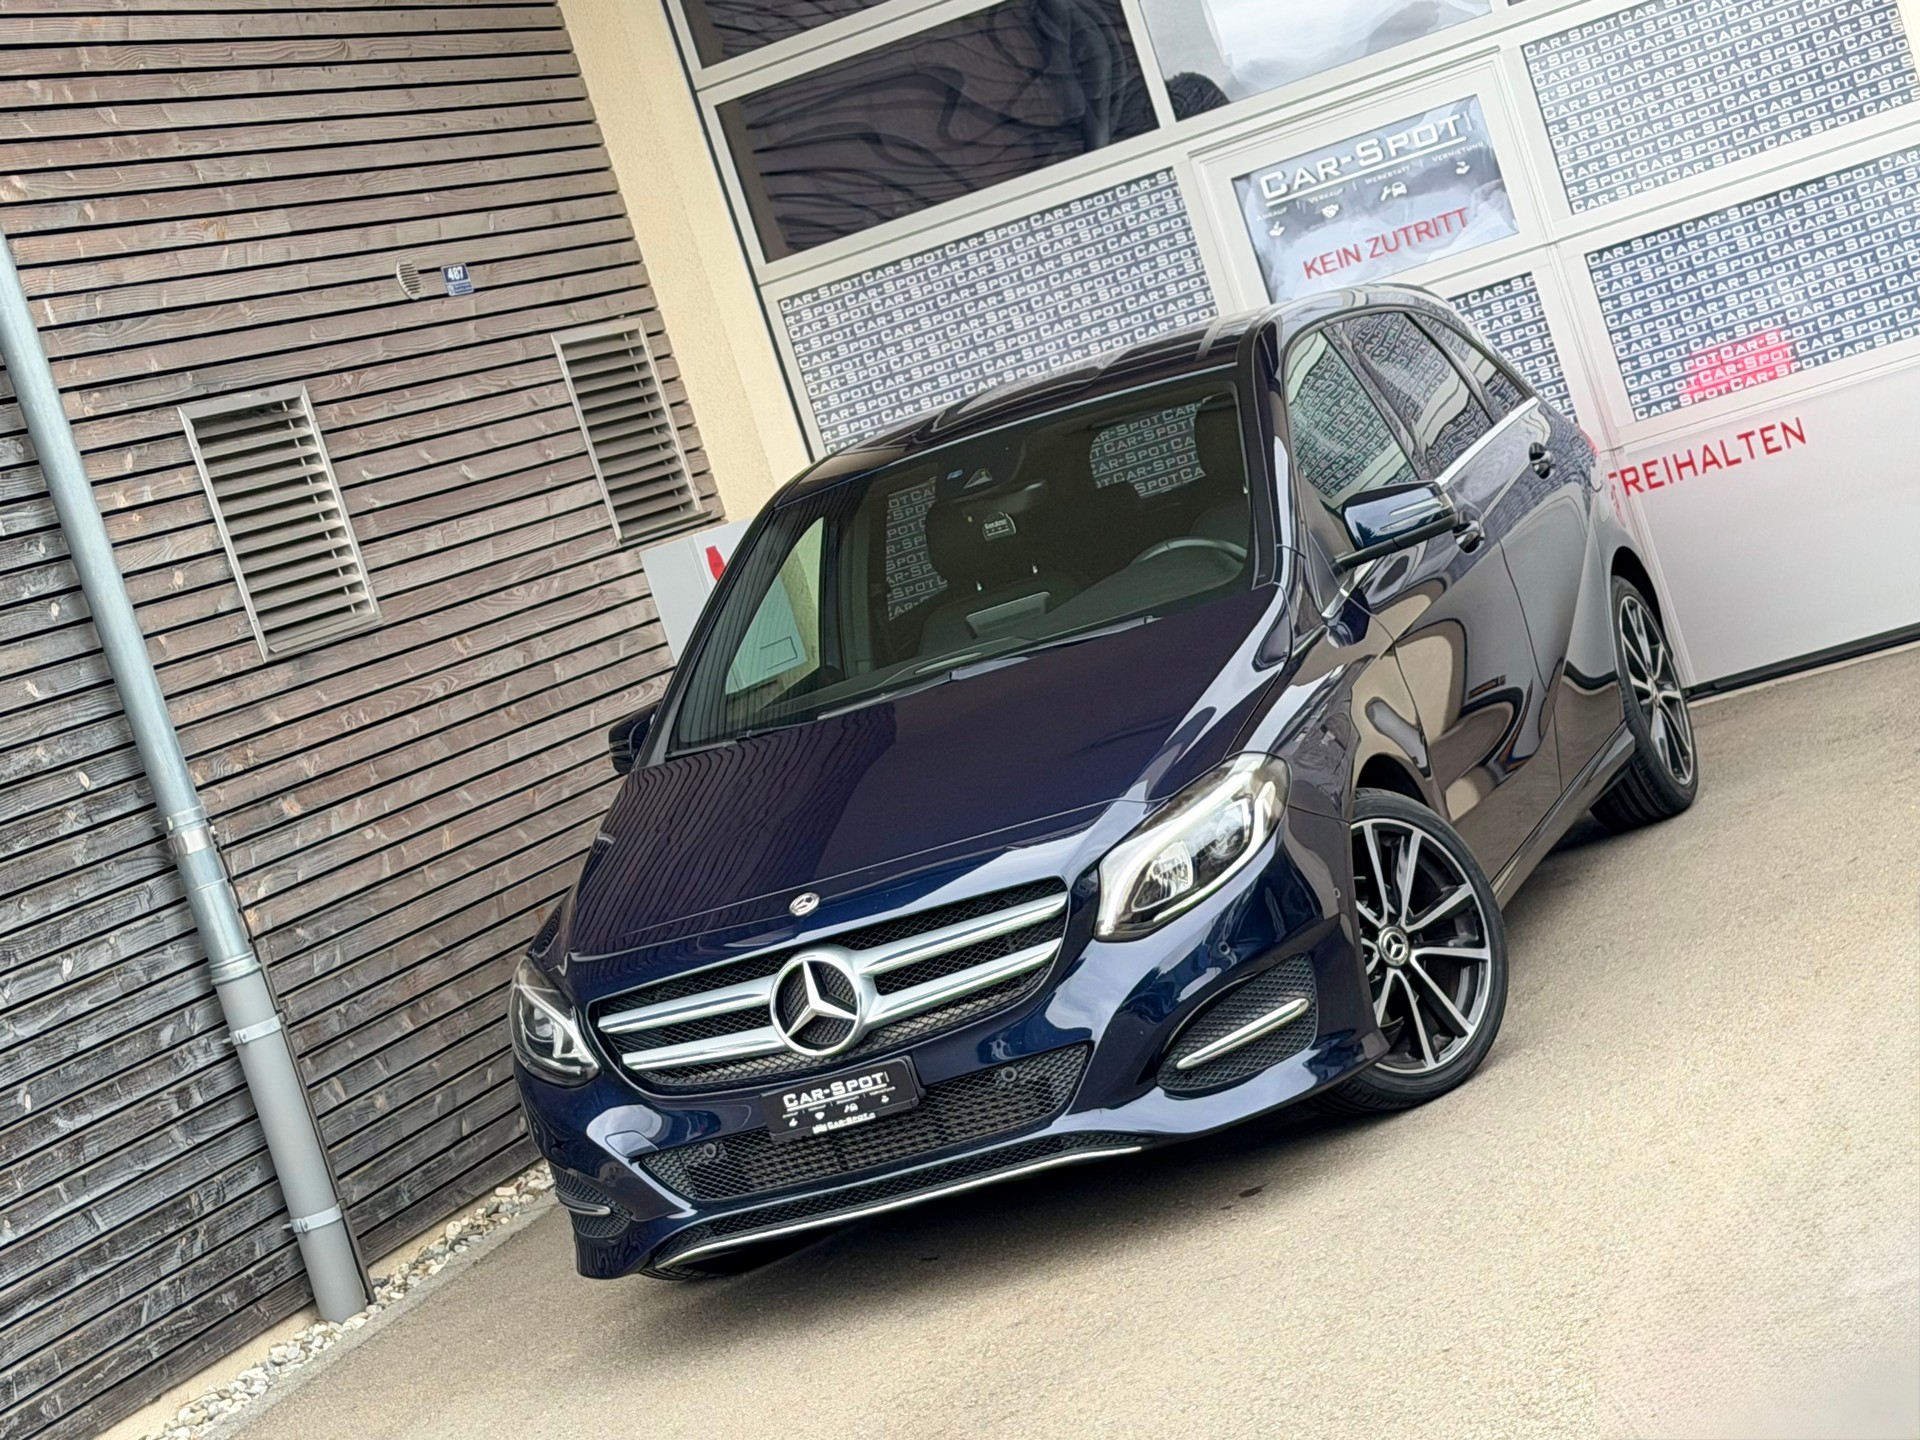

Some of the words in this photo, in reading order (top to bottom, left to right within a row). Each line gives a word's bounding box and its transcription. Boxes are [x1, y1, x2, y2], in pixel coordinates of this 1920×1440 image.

[1523, 16, 1615, 57] CAR-SPOT
[1532, 46, 1625, 87] CAR-SPOT
[1627, 12, 1723, 55] CAR-SPOT
[1542, 78, 1635, 119] CAR-SPOT
[1637, 45, 1731, 86] CAR-SPOT
[1734, 11, 1830, 53] CAR-SPOT
[1597, 7, 1691, 49] CAR-SPOT
[1606, 38, 1701, 80] CAR-SPOT
[1703, 4, 1799, 47] CAR-SPOT
[1616, 70, 1711, 111] CAR-SPOT
[1713, 36, 1809, 78] CAR-SPOT
[1551, 109, 1644, 149] CAR-SPOT
[1646, 76, 1741, 117] CAR-SPOT
[1744, 42, 1840, 84] CAR-SPOT
[1561, 141, 1655, 181] CAR-SPOT
[1656, 108, 1751, 149] CAR-SPOT
[1753, 75, 1850, 117] CAR-SPOT
[1625, 100, 1720, 141] CAR-SPOT
[1722, 67, 1817, 109] CAR-SPOT
[1635, 134, 1729, 174] CAR-SPOT
[1732, 100, 1828, 142] CAR-SPOT
[1259, 114, 1461, 200] CAR-SPOT
[1571, 173, 1664, 213] CAR-SPOT
[1666, 141, 1761, 182] CAR-SPOT
[1763, 108, 1859, 149] CAR-SPOT
[780, 276, 860, 312] CAR-SPOT
[861, 248, 944, 284] CAR-SPOT
[944, 219, 1028, 256] CAR-SPOT
[1028, 190, 1114, 227] CAR-SPOT
[843, 270, 926, 306] CAR-SPOT
[926, 242, 1009, 279] CAR-SPOT
[1011, 213, 1095, 250] CAR-SPOT
[1303, 243, 1362, 279] KEIN
[1365, 206, 1470, 260] ZUTRITT
[1586, 227, 1679, 266] CAR-SPOT
[1681, 195, 1777, 235] CAR-SPOT
[1778, 163, 1876, 203] CAR-SPOT
[1595, 257, 1689, 296] CAR-SPOT
[1690, 226, 1786, 265] CAR-SPOT
[1787, 194, 1885, 234] CAR-SPOT
[1660, 220, 1755, 259] CAR-SPOT
[1756, 188, 1854, 228] CAR-SPOT
[1669, 251, 1764, 290] CAR-SPOT
[1766, 219, 1863, 259] CAR-SPOT
[448, 266, 463, 280] 487
[789, 305, 870, 341] CAR-SPOT
[870, 277, 953, 313] CAR-SPOT
[953, 249, 1037, 286] CAR-SPOT
[1037, 219, 1123, 257] CAR-SPOT
[798, 334, 879, 370] CAR-SPOT
[879, 306, 962, 342] CAR-SPOT
[962, 278, 1046, 315] CAR-SPOT
[1047, 249, 1132, 287] CAR-SPOT
[852, 299, 935, 336] CAR-SPOT
[935, 271, 1019, 308] CAR-SPOT
[1020, 242, 1105, 279] CAR-SPOT
[861, 329, 944, 365] CAR-SPOT
[944, 301, 1028, 338] CAR-SPOT
[1029, 272, 1114, 310] CAR-SPOT
[1605, 289, 1699, 328] CAR-SPOT
[1700, 258, 1796, 298] CAR-SPOT
[1797, 226, 1895, 266] CAR-SPOT
[1614, 320, 1708, 358] CAR-SPOT
[1709, 289, 1805, 328] CAR-SPOT
[1807, 257, 1904, 297] CAR-SPOT
[1679, 282, 1774, 322] CAR-SPOT
[1775, 251, 1873, 291] CAR-SPOT
[1688, 313, 1783, 352] CAR-SPOT
[1785, 282, 1882, 321] CAR-SPOT
[806, 363, 887, 398] CAR-SPOT
[888, 335, 971, 371] CAR-SPOT
[971, 307, 1055, 344] CAR-SPOT
[1056, 278, 1141, 316] CAR-SPOT
[815, 392, 897, 428] CAR-SPOT
[897, 365, 980, 401] CAR-SPOT
[980, 337, 1064, 374] CAR-SPOT
[1065, 308, 1151, 346] CAR-SPOT
[870, 357, 953, 393] CAR-SPOT
[953, 329, 1037, 366] CAR-SPOT
[1038, 301, 1123, 338] CAR-SPOT
[880, 388, 963, 424] CAR-SPOT
[963, 360, 1047, 397] CAR-SPOT
[1047, 332, 1133, 369] CAR-SPOT
[1624, 351, 1718, 390] CAR-SPOT
[1719, 321, 1815, 360] CAR-SPOT
[1816, 290, 1914, 329] CAR-SPOT
[1698, 346, 1793, 384] CAR-SPOT
[1795, 315, 1892, 354] CAR-SPOT
[1634, 383, 1728, 421] CAR-SPOT
[1729, 353, 1825, 392] CAR-SPOT
[1104, 419, 1187, 453] CAR-SPOT
[783, 1072, 884, 1108] CAR-SPOT
